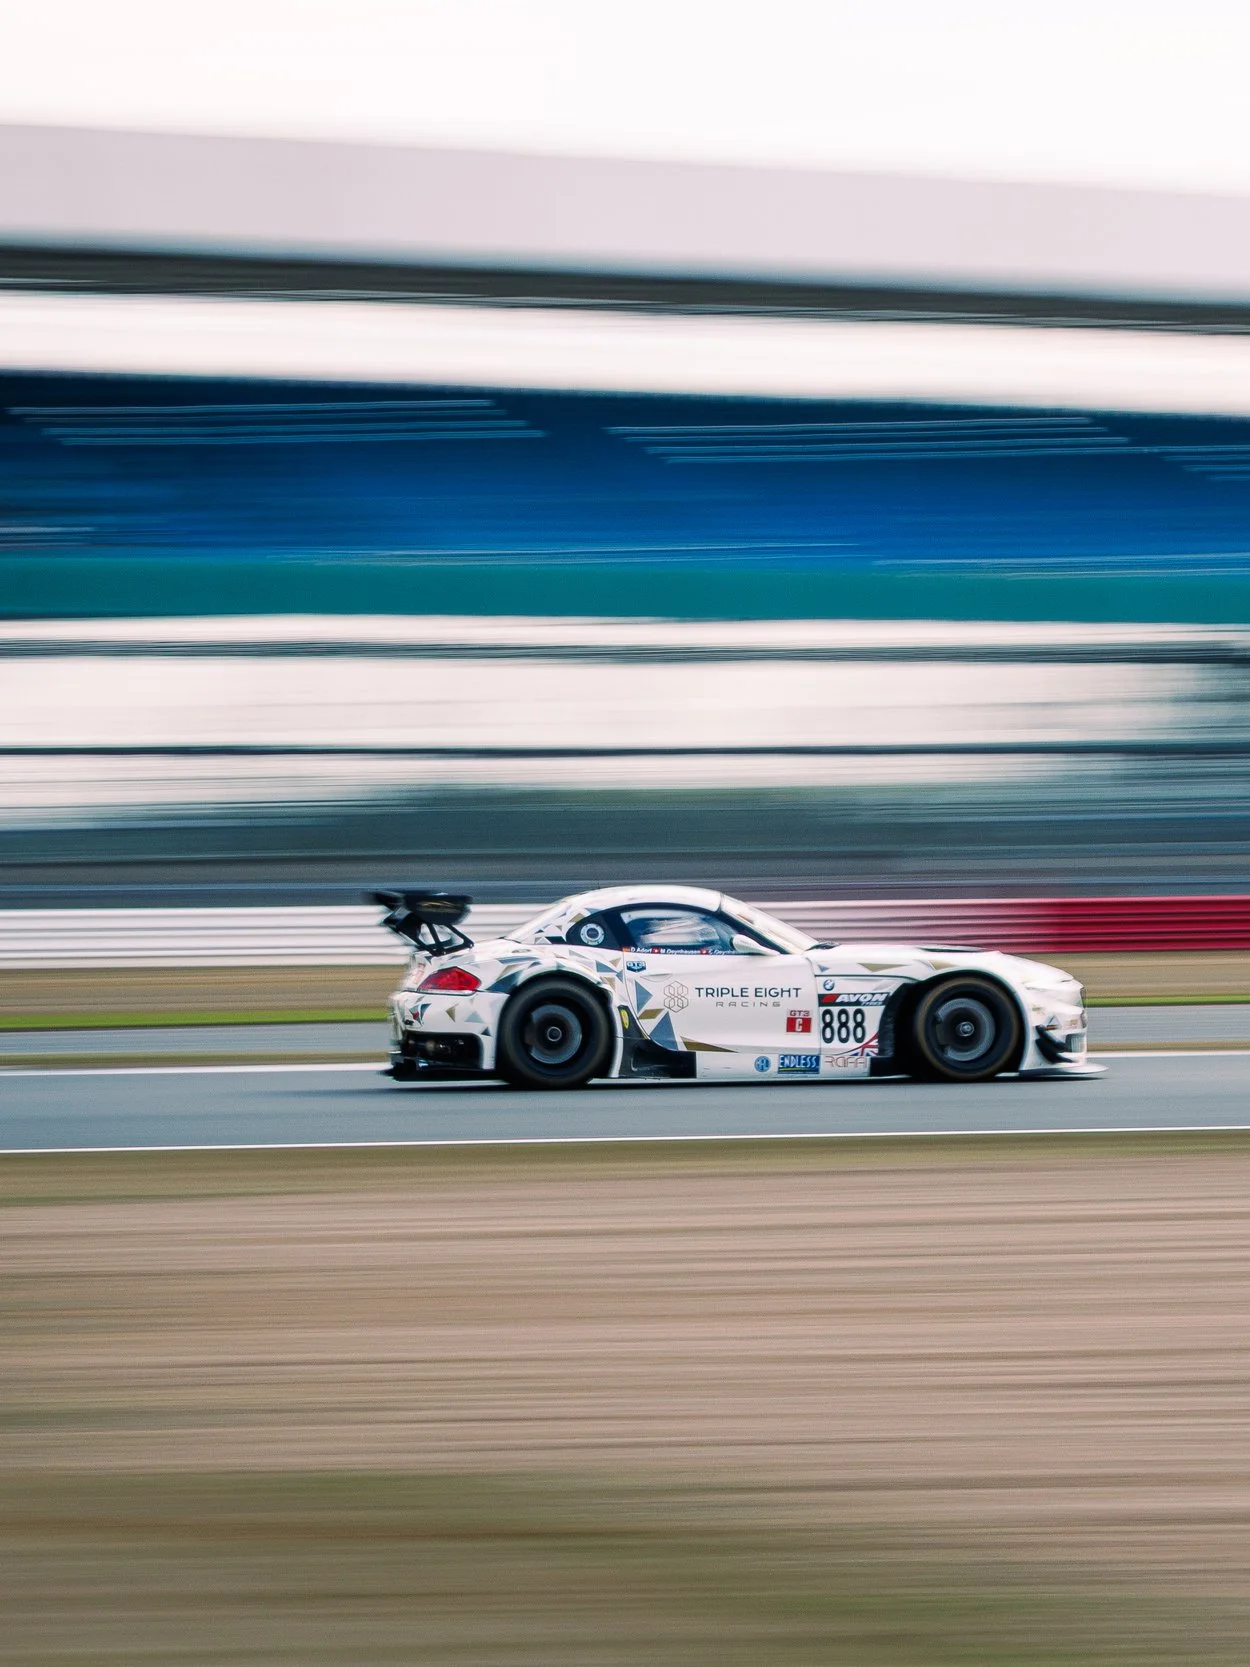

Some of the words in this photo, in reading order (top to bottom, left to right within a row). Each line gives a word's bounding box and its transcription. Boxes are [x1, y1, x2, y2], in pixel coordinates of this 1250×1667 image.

[695, 987, 749, 998] TRIPLE
[754, 987, 802, 998] EIGHT
[836, 993, 888, 1003] AVON
[795, 1018, 803, 1032] C
[822, 1008, 866, 1044] 888
[779, 1055, 817, 1068] ENDLESS
